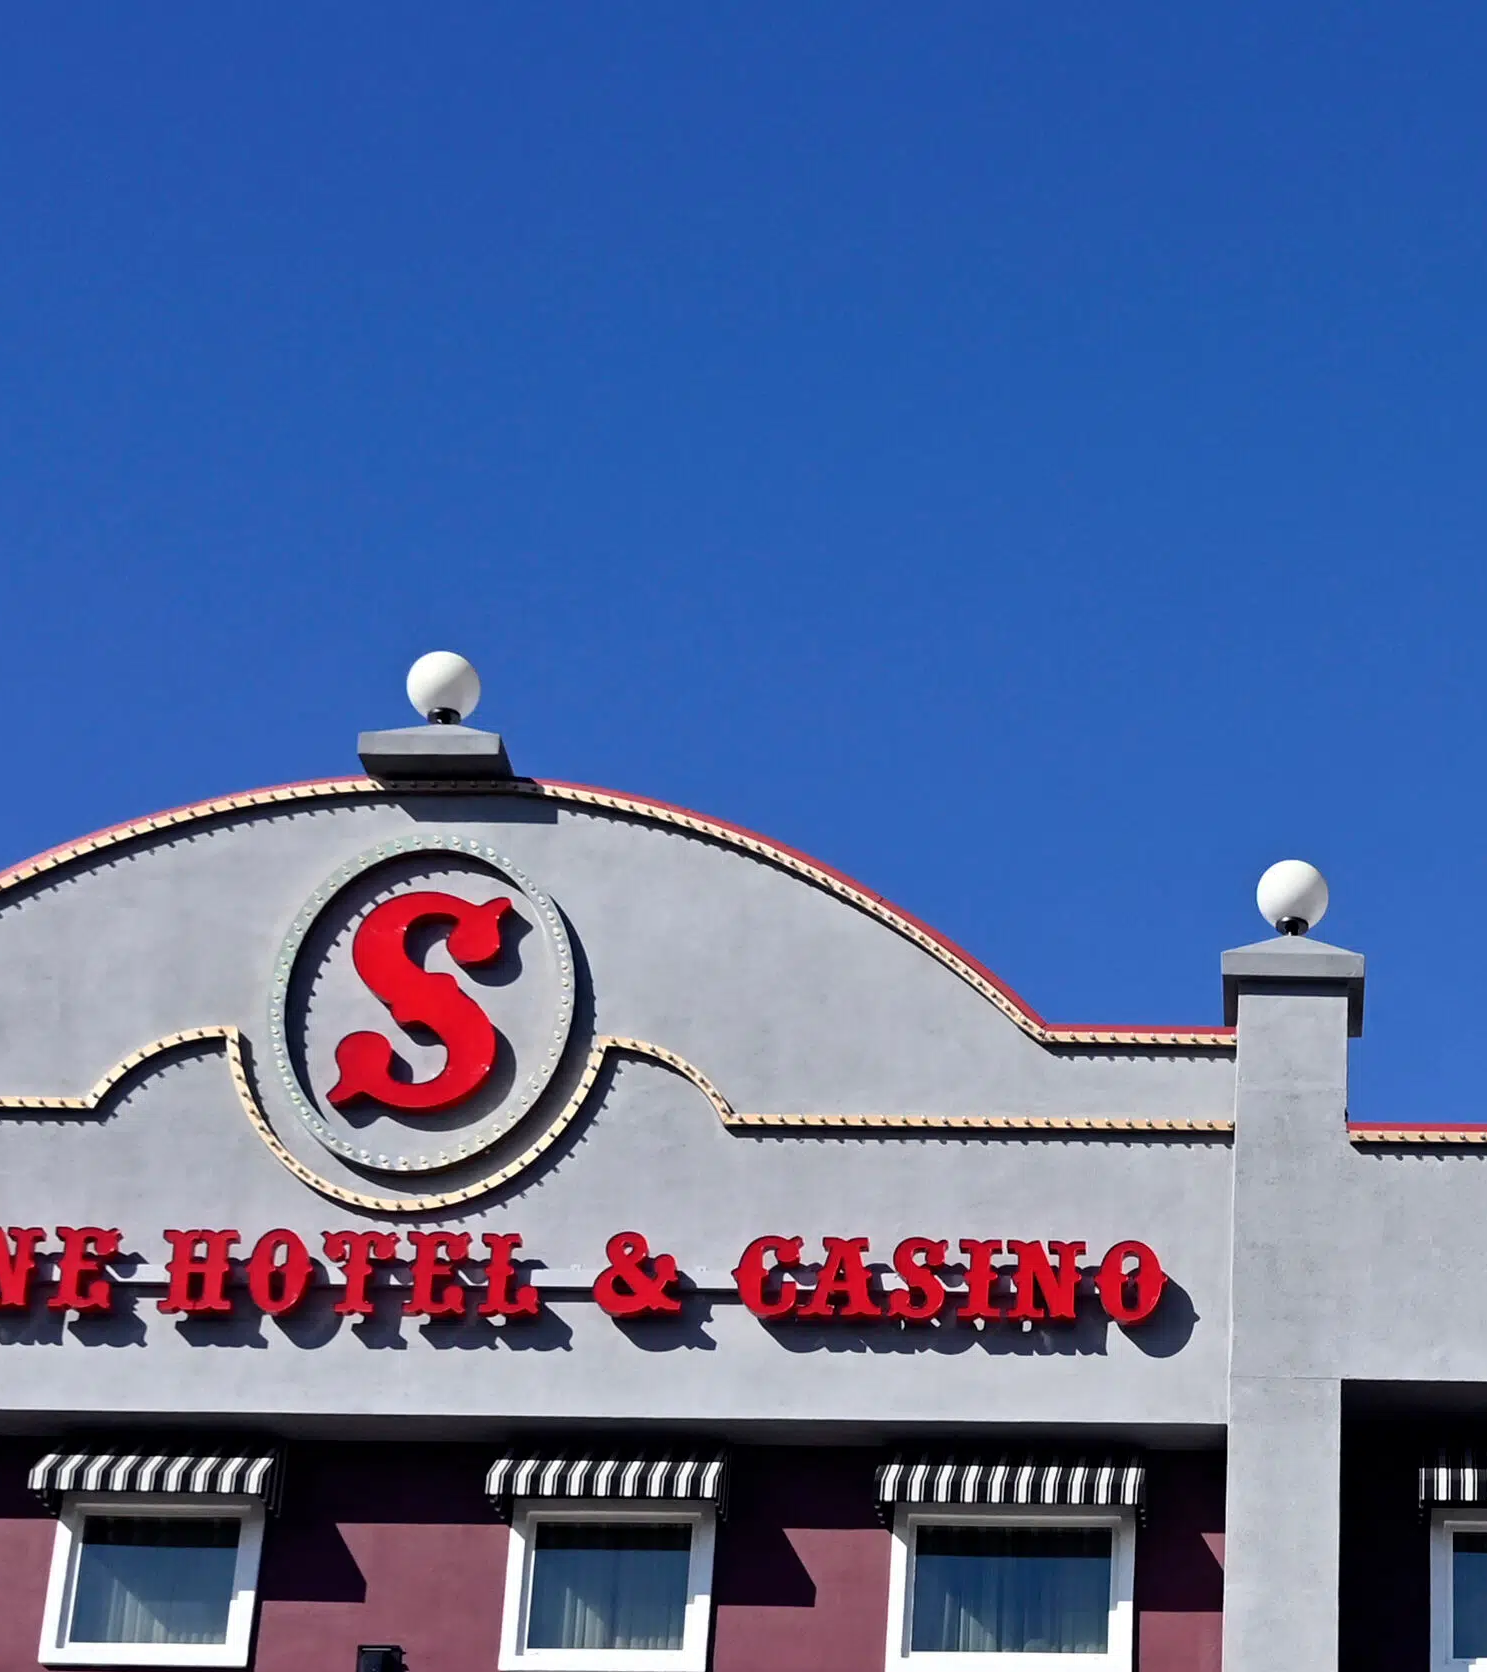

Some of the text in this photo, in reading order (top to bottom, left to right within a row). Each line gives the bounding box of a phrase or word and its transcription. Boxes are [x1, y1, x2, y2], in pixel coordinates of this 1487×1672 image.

[326, 891, 512, 1112] S
[157, 1228, 541, 1318] HOTEL
[590, 1230, 683, 1320] &
[731, 1234, 1170, 1327] CASINO
